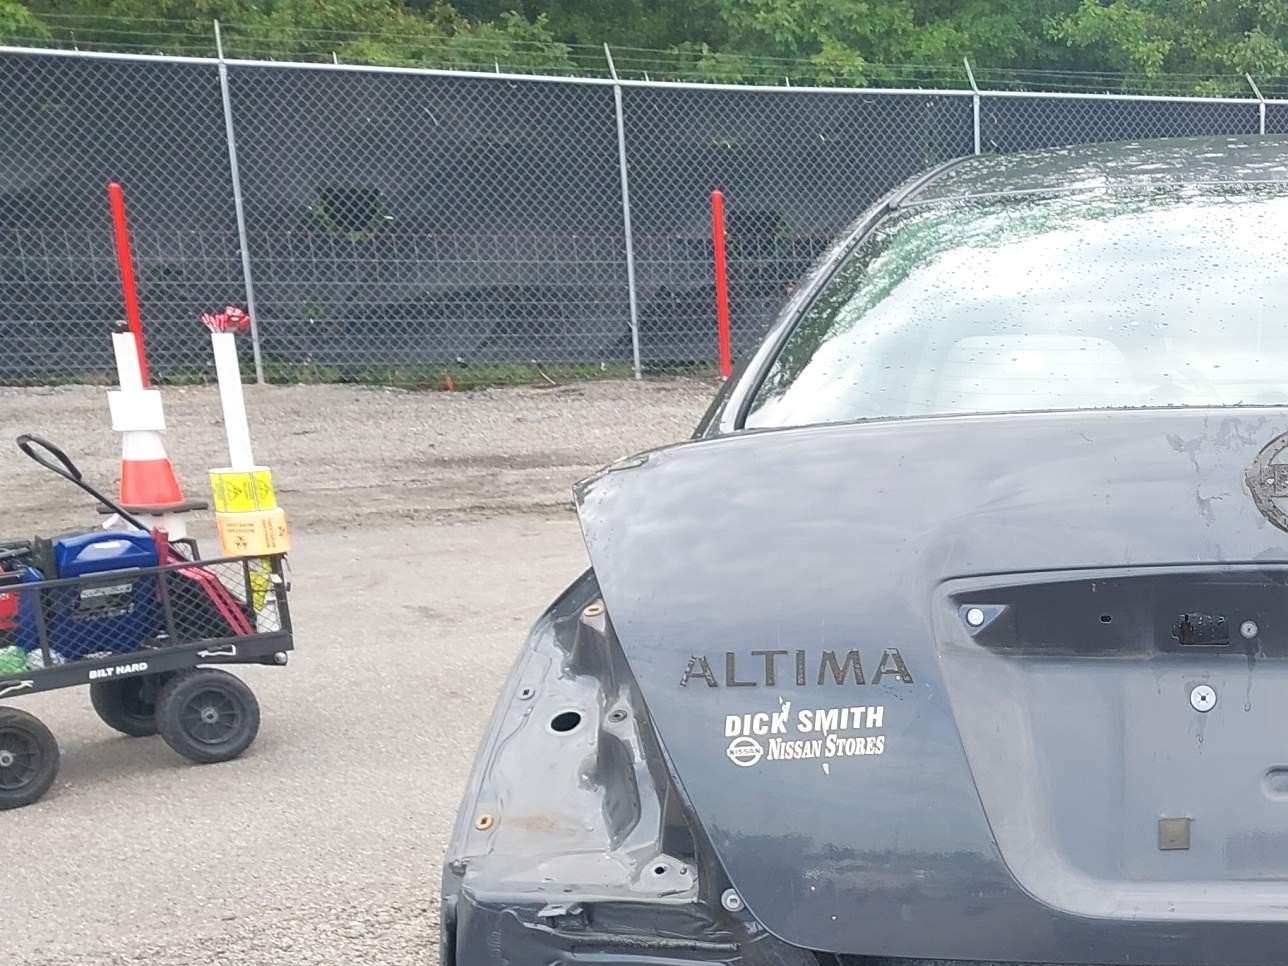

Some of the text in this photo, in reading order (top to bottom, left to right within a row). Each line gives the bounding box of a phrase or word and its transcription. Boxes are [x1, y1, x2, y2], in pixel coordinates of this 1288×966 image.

[89, 662, 148, 679] BILT HARD
[680, 648, 914, 688] ALTIMA
[725, 706, 884, 737] DICK SMITH
